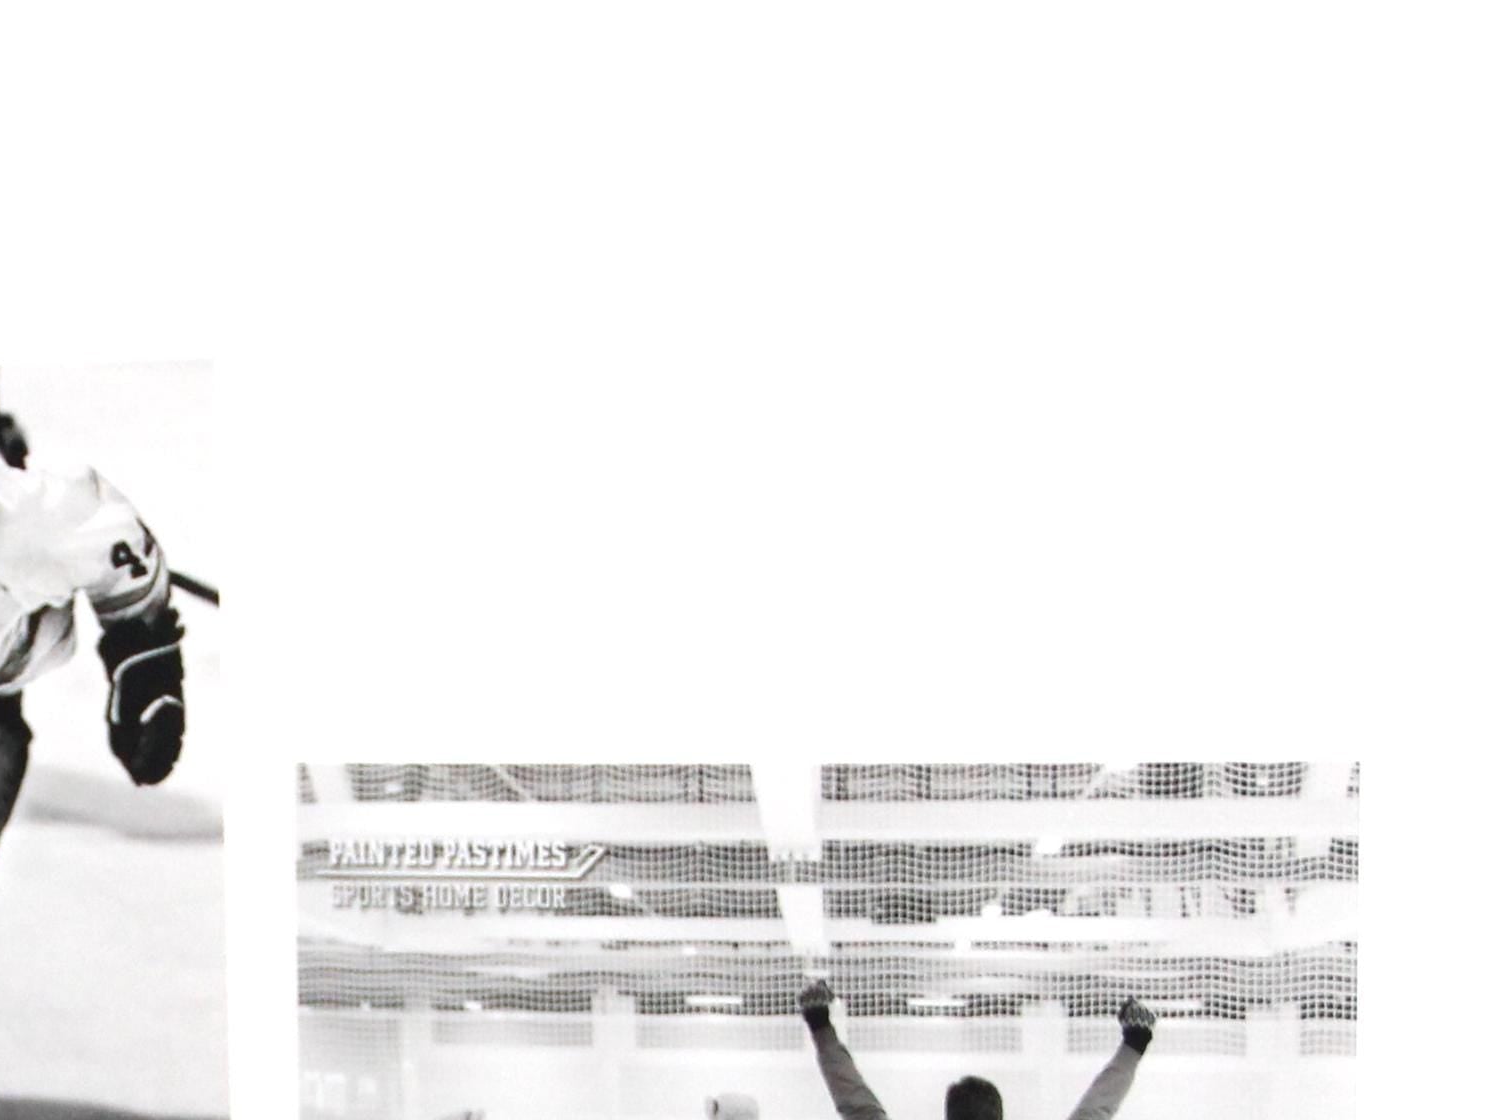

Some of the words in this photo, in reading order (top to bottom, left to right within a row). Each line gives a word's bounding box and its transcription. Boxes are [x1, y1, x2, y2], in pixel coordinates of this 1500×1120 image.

[329, 840, 437, 867] PAINTED
[442, 840, 568, 868] PASTIMES
[332, 884, 415, 910] SPORTS
[421, 884, 489, 910] HOME
[497, 884, 568, 911] DECOR
